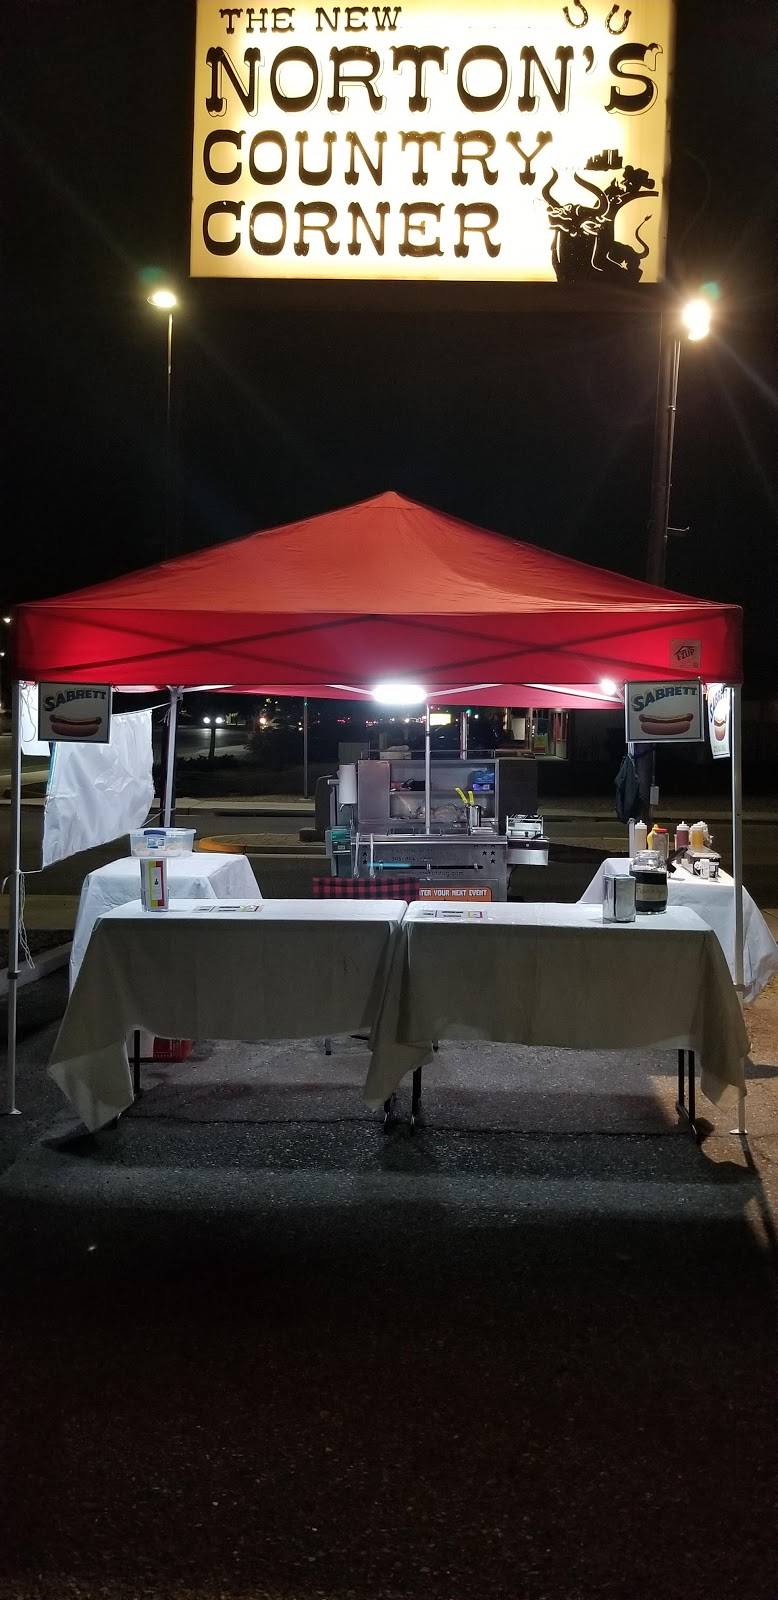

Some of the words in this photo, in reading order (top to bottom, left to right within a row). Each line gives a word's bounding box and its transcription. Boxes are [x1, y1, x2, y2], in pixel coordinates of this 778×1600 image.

[220, 7, 295, 34] THE
[315, 5, 403, 33] NEW
[204, 41, 664, 115] NORTON'S
[202, 129, 553, 186] COUNTRY
[202, 200, 503, 258] CORNER
[43, 687, 107, 711] SABRETT
[631, 685, 698, 712] SABRETT
[433, 889, 450, 897] YOUR
[451, 889, 467, 897] NEXT
[468, 889, 488, 897] EVENT
